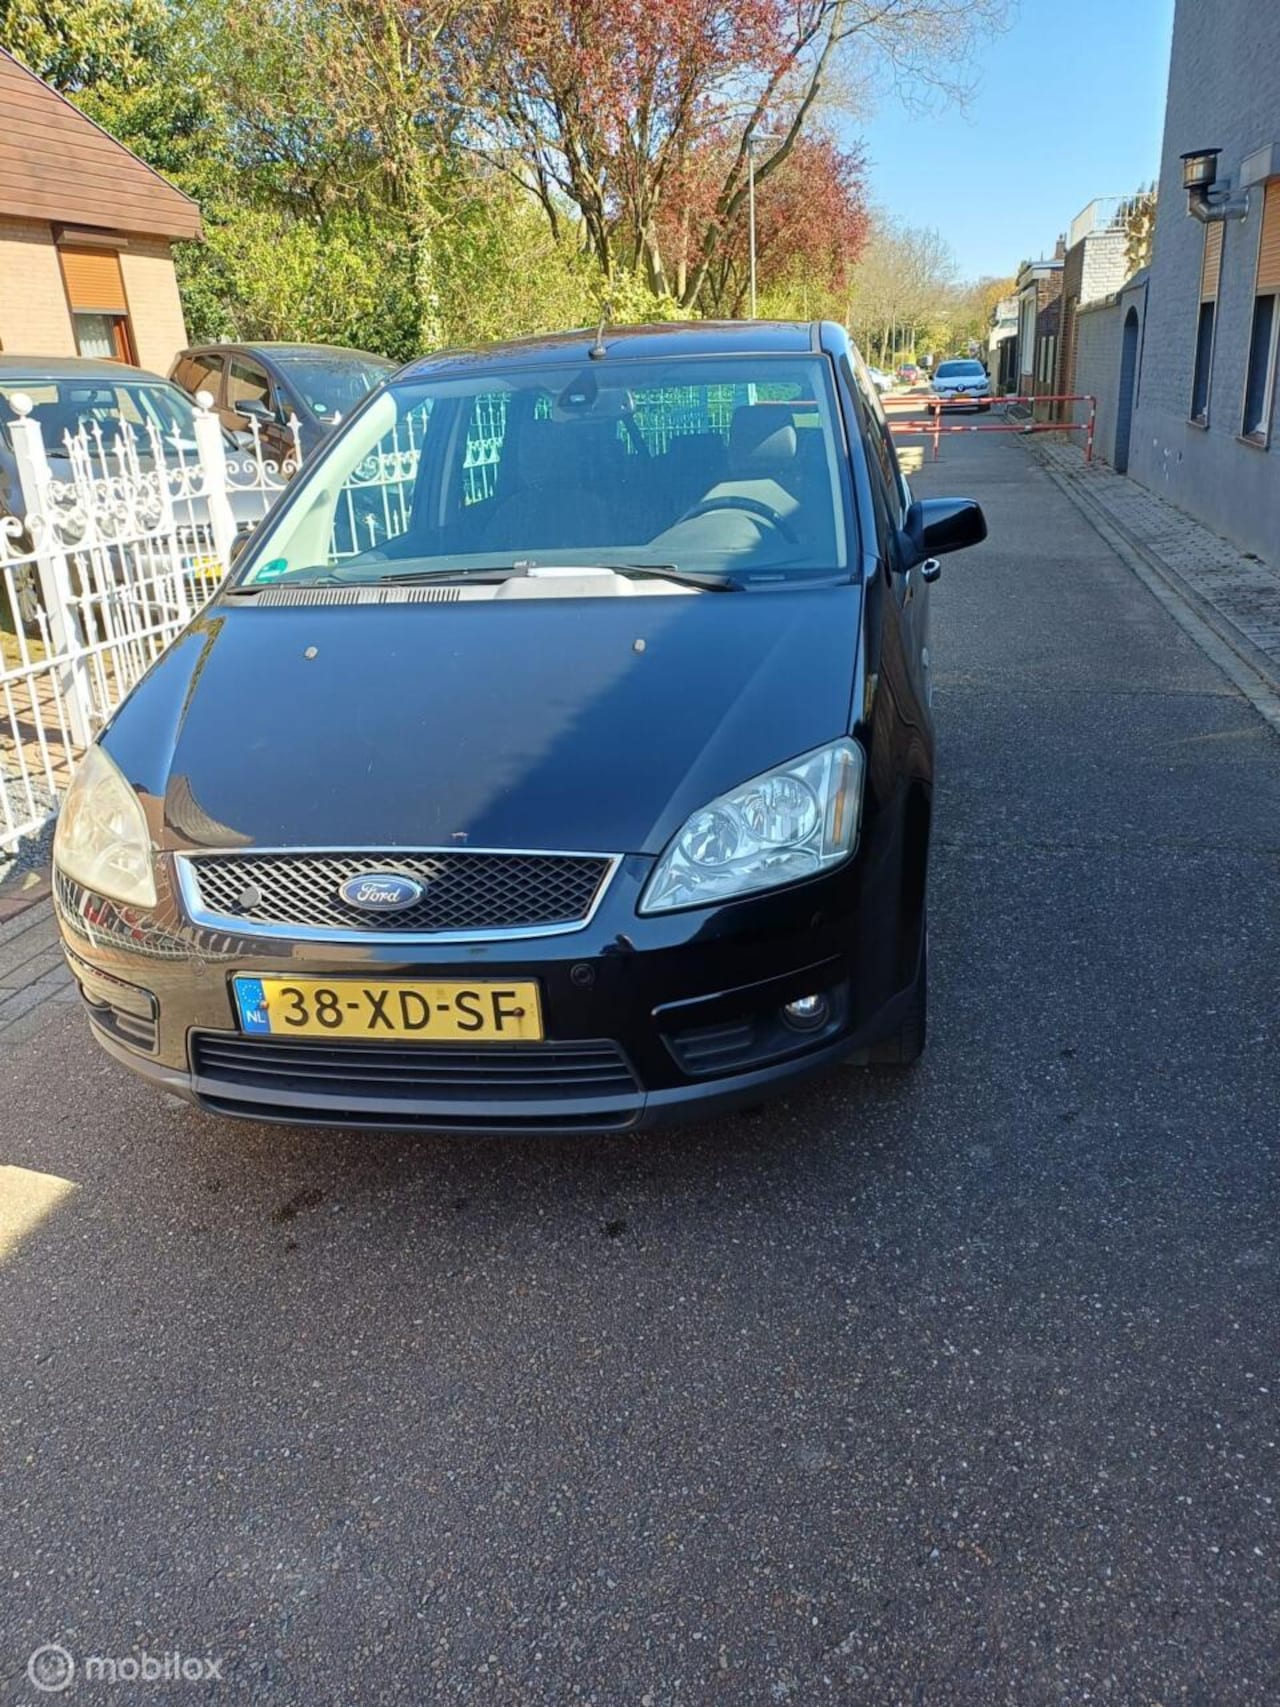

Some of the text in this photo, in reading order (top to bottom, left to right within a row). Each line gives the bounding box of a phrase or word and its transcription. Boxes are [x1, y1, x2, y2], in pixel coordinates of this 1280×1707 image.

[357, 882, 401, 902] Ford
[246, 1010, 267, 1024] NL
[280, 987, 517, 1032] 38-XD-SF
